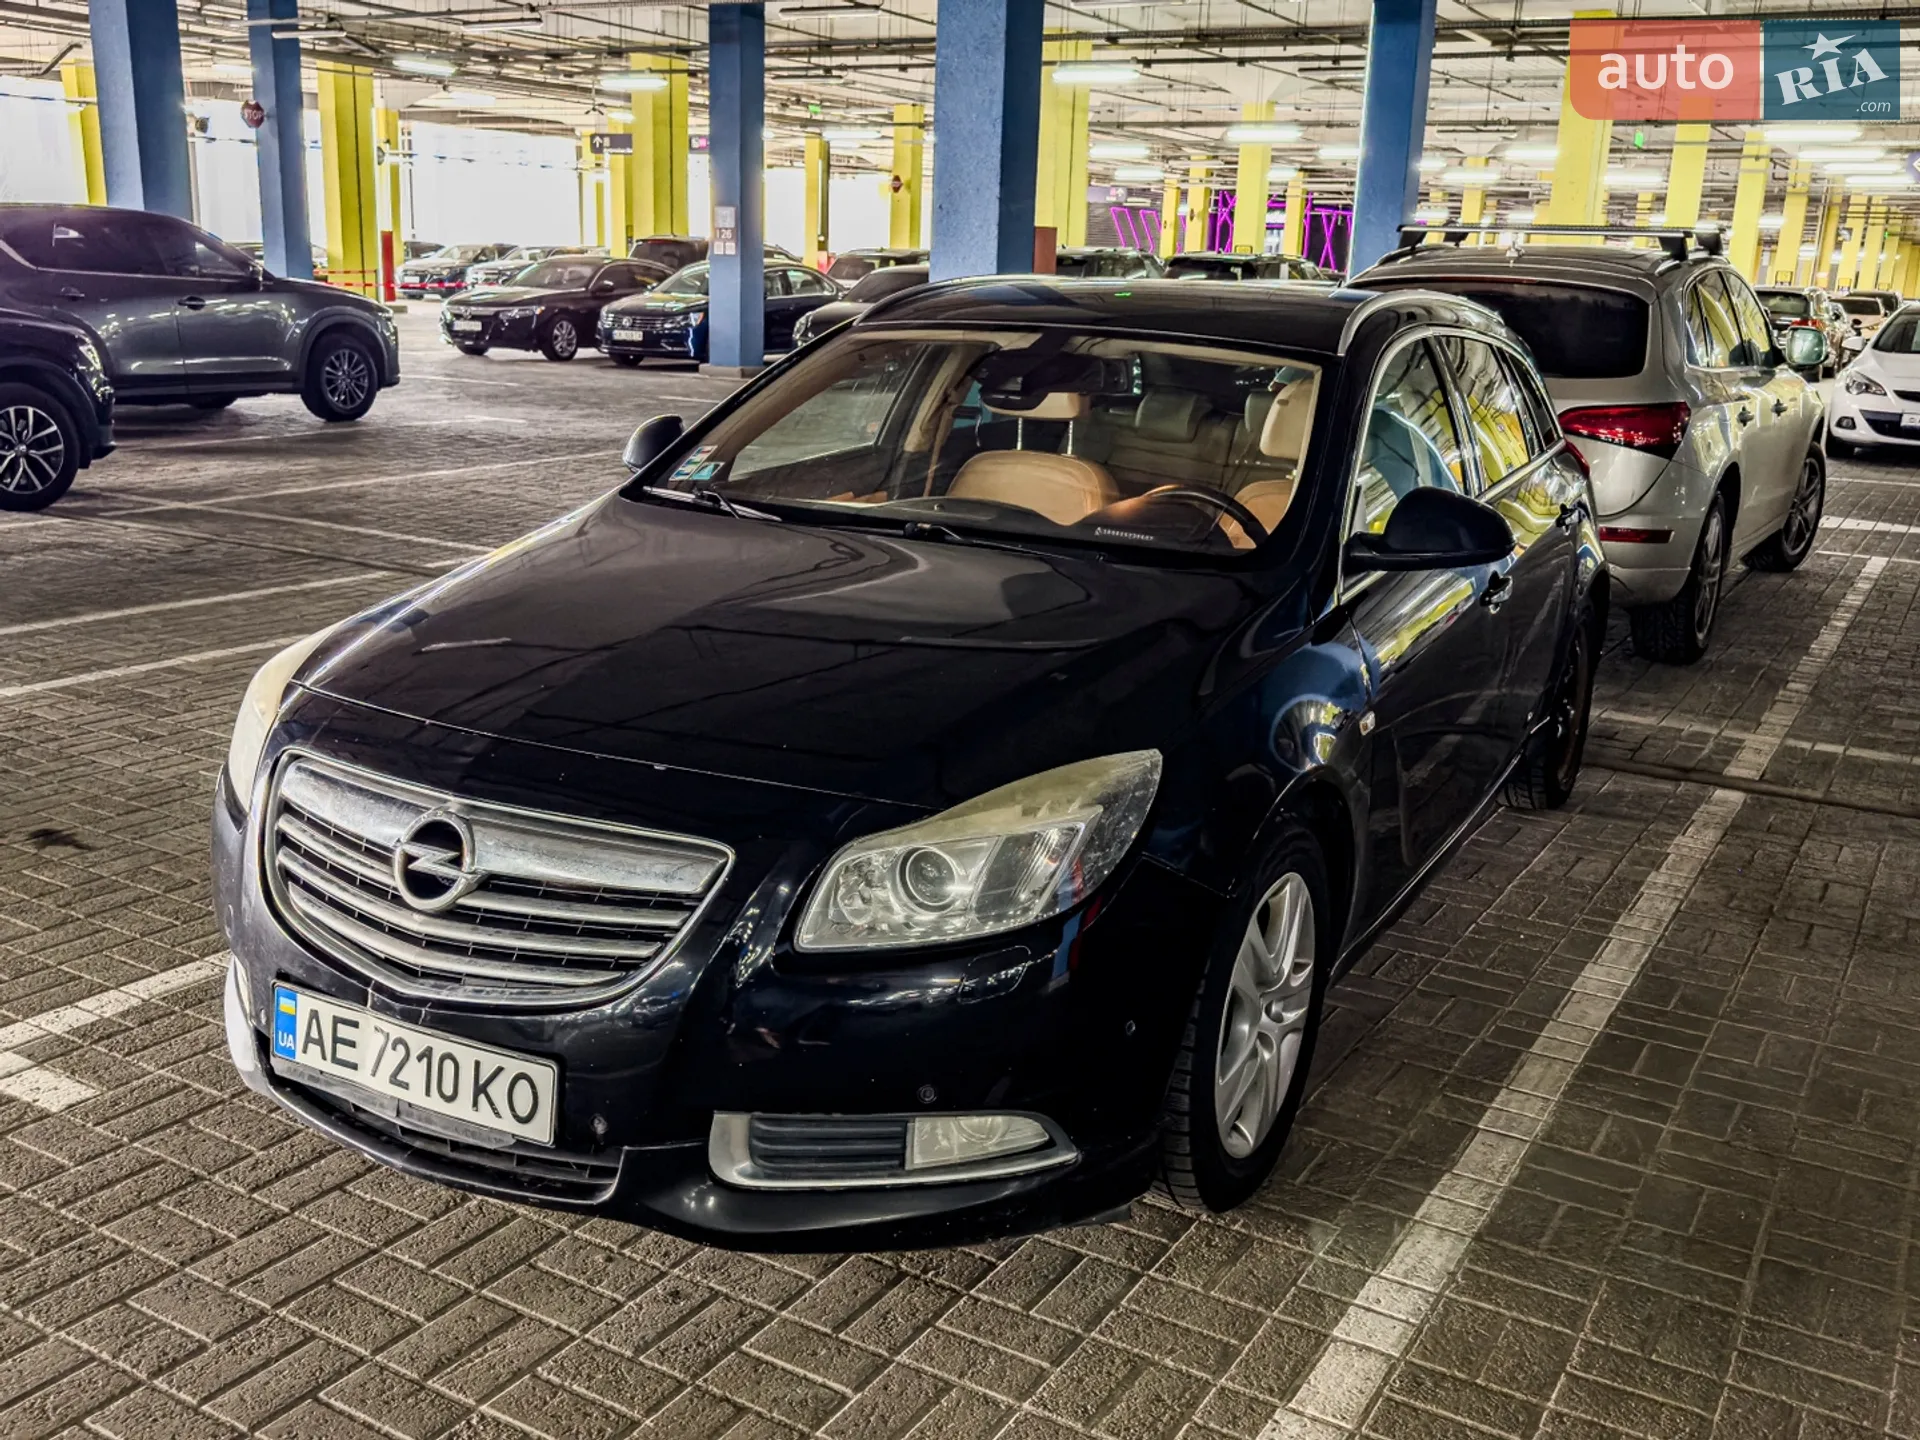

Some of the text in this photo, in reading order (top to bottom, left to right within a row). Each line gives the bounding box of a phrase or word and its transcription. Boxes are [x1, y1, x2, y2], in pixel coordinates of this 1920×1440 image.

[244, 109, 263, 119] STOP
[278, 1031, 294, 1049] UA
[301, 1009, 360, 1071] AE
[370, 1026, 460, 1103] 7210
[471, 1059, 539, 1124] KO
